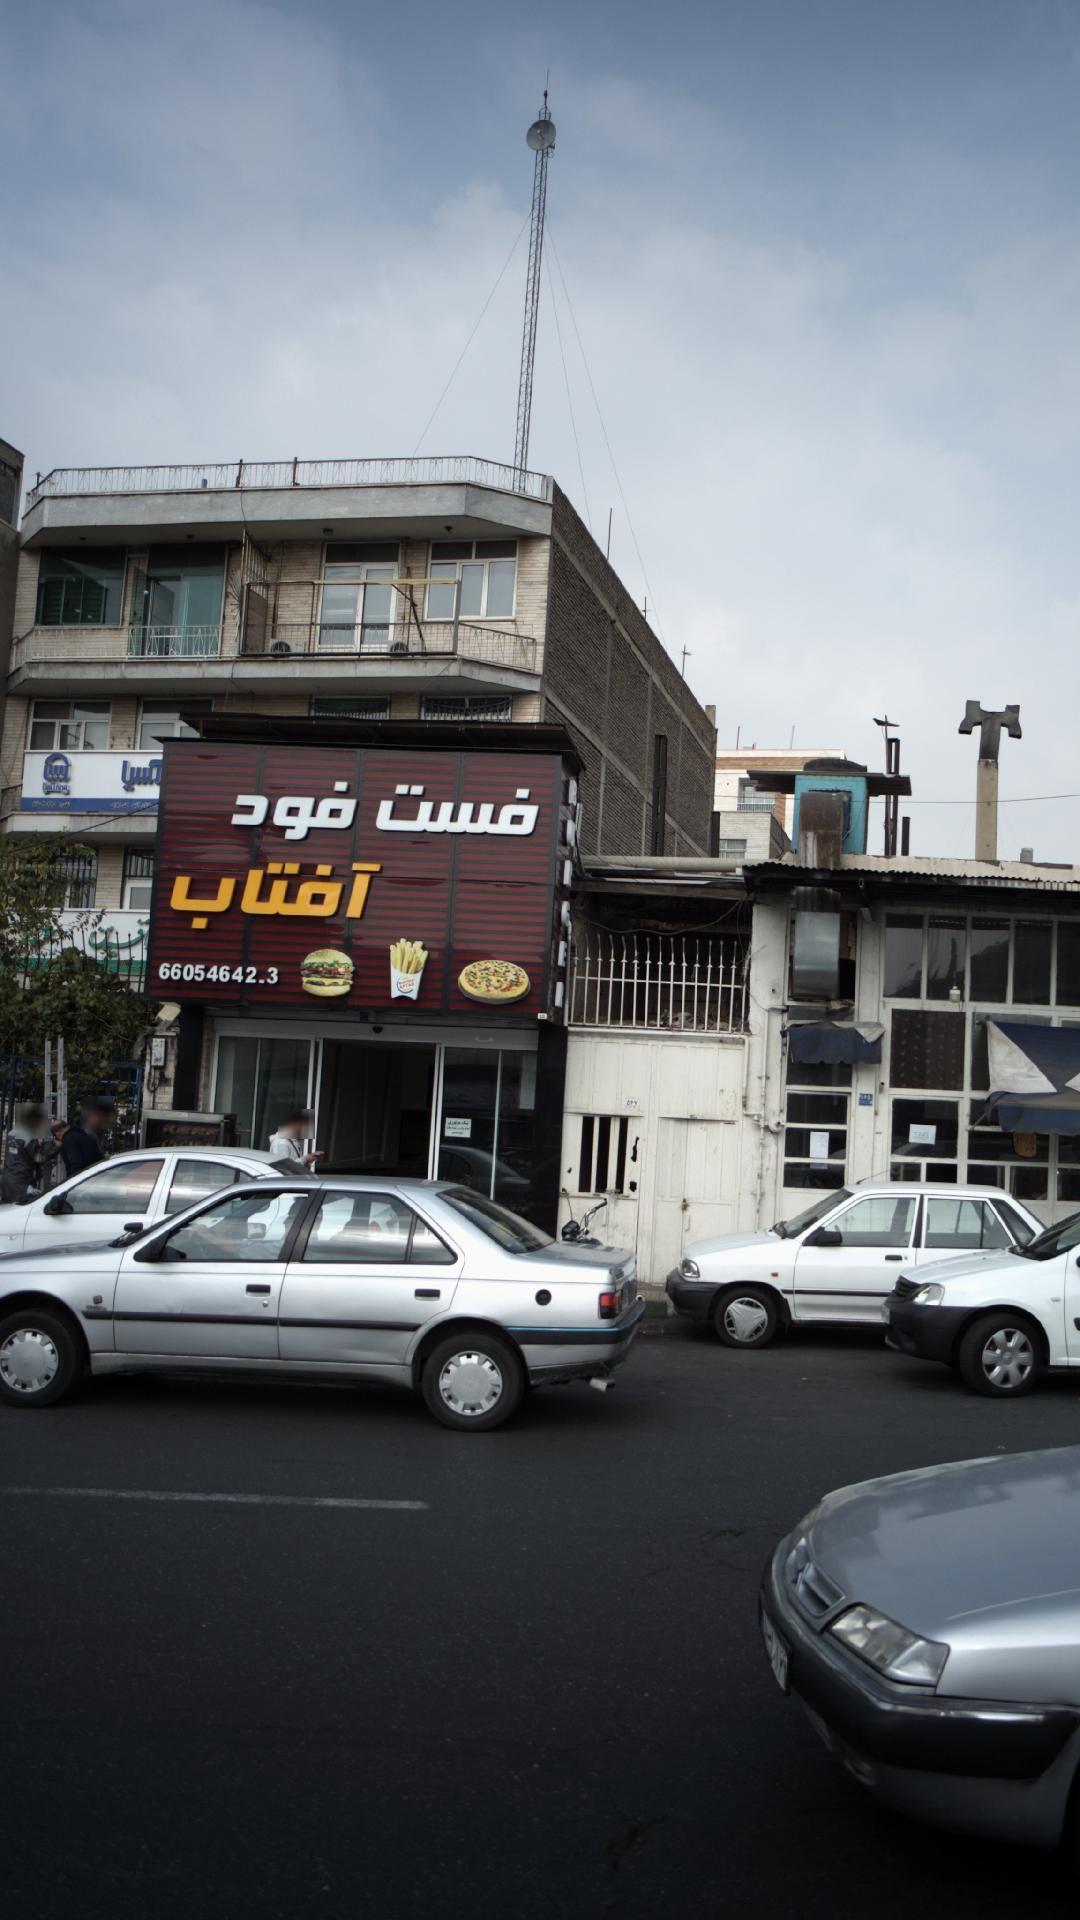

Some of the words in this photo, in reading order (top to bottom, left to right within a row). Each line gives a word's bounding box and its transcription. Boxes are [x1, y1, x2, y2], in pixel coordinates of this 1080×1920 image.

[231, 781, 358, 840] فود
[375, 784, 539, 835] فست
[170, 862, 382, 929] آفتاب
